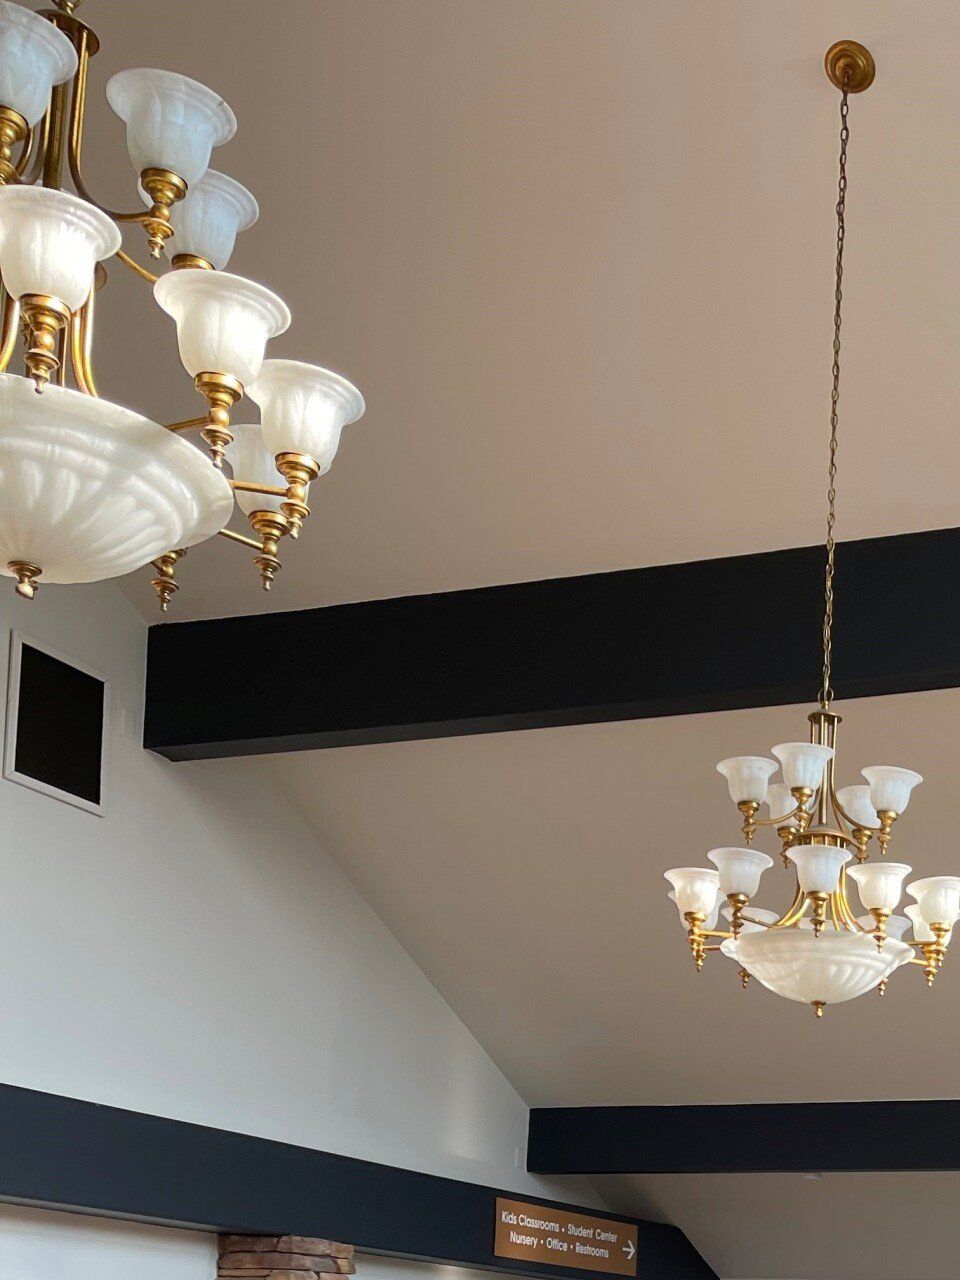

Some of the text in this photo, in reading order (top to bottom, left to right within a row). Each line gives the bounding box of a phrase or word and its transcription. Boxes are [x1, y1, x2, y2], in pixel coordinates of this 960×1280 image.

[501, 1211, 618, 1243] Kids Classrooms Student Center
[509, 1230, 609, 1258] Nursery Office Restrooms
